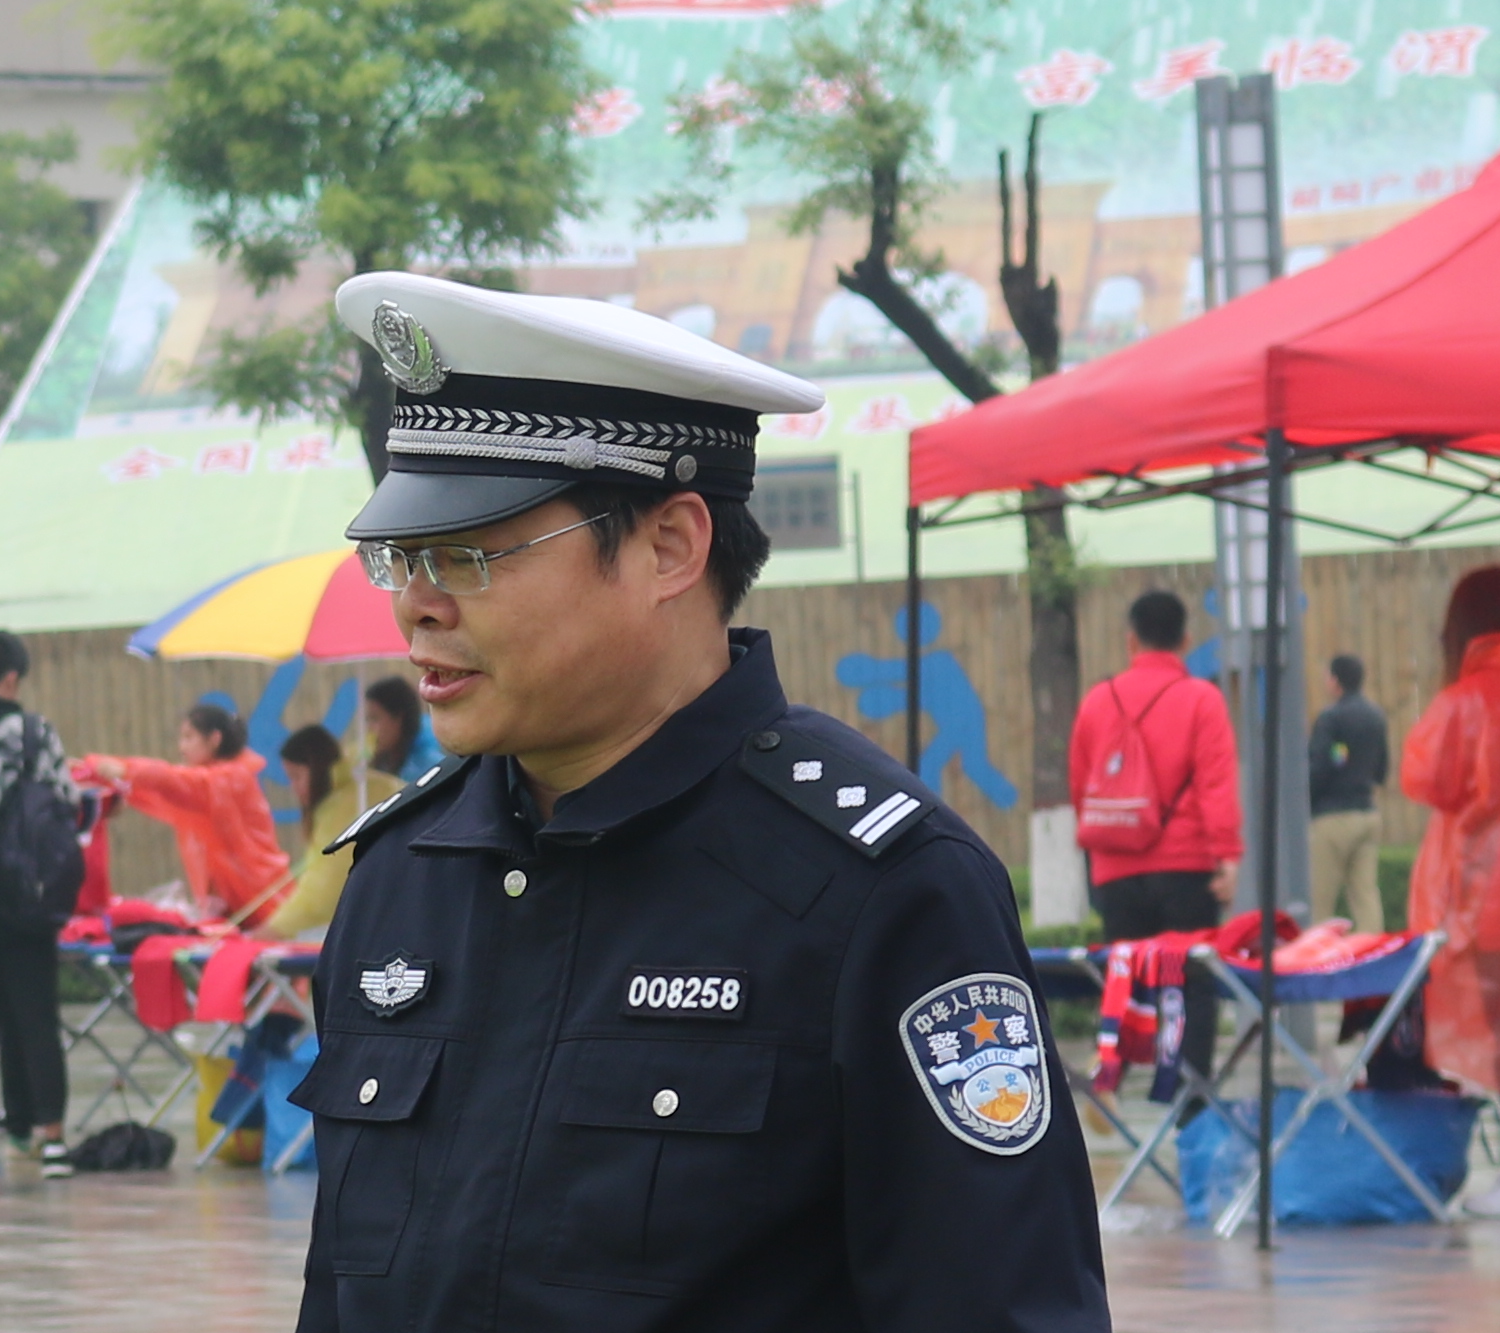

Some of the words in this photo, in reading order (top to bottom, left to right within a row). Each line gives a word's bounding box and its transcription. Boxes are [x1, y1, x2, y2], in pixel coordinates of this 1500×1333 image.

[628, 975, 740, 1011] 008258
[913, 984, 1028, 1035] 中华人民共和国
[964, 1050, 1016, 1073] POLICE
